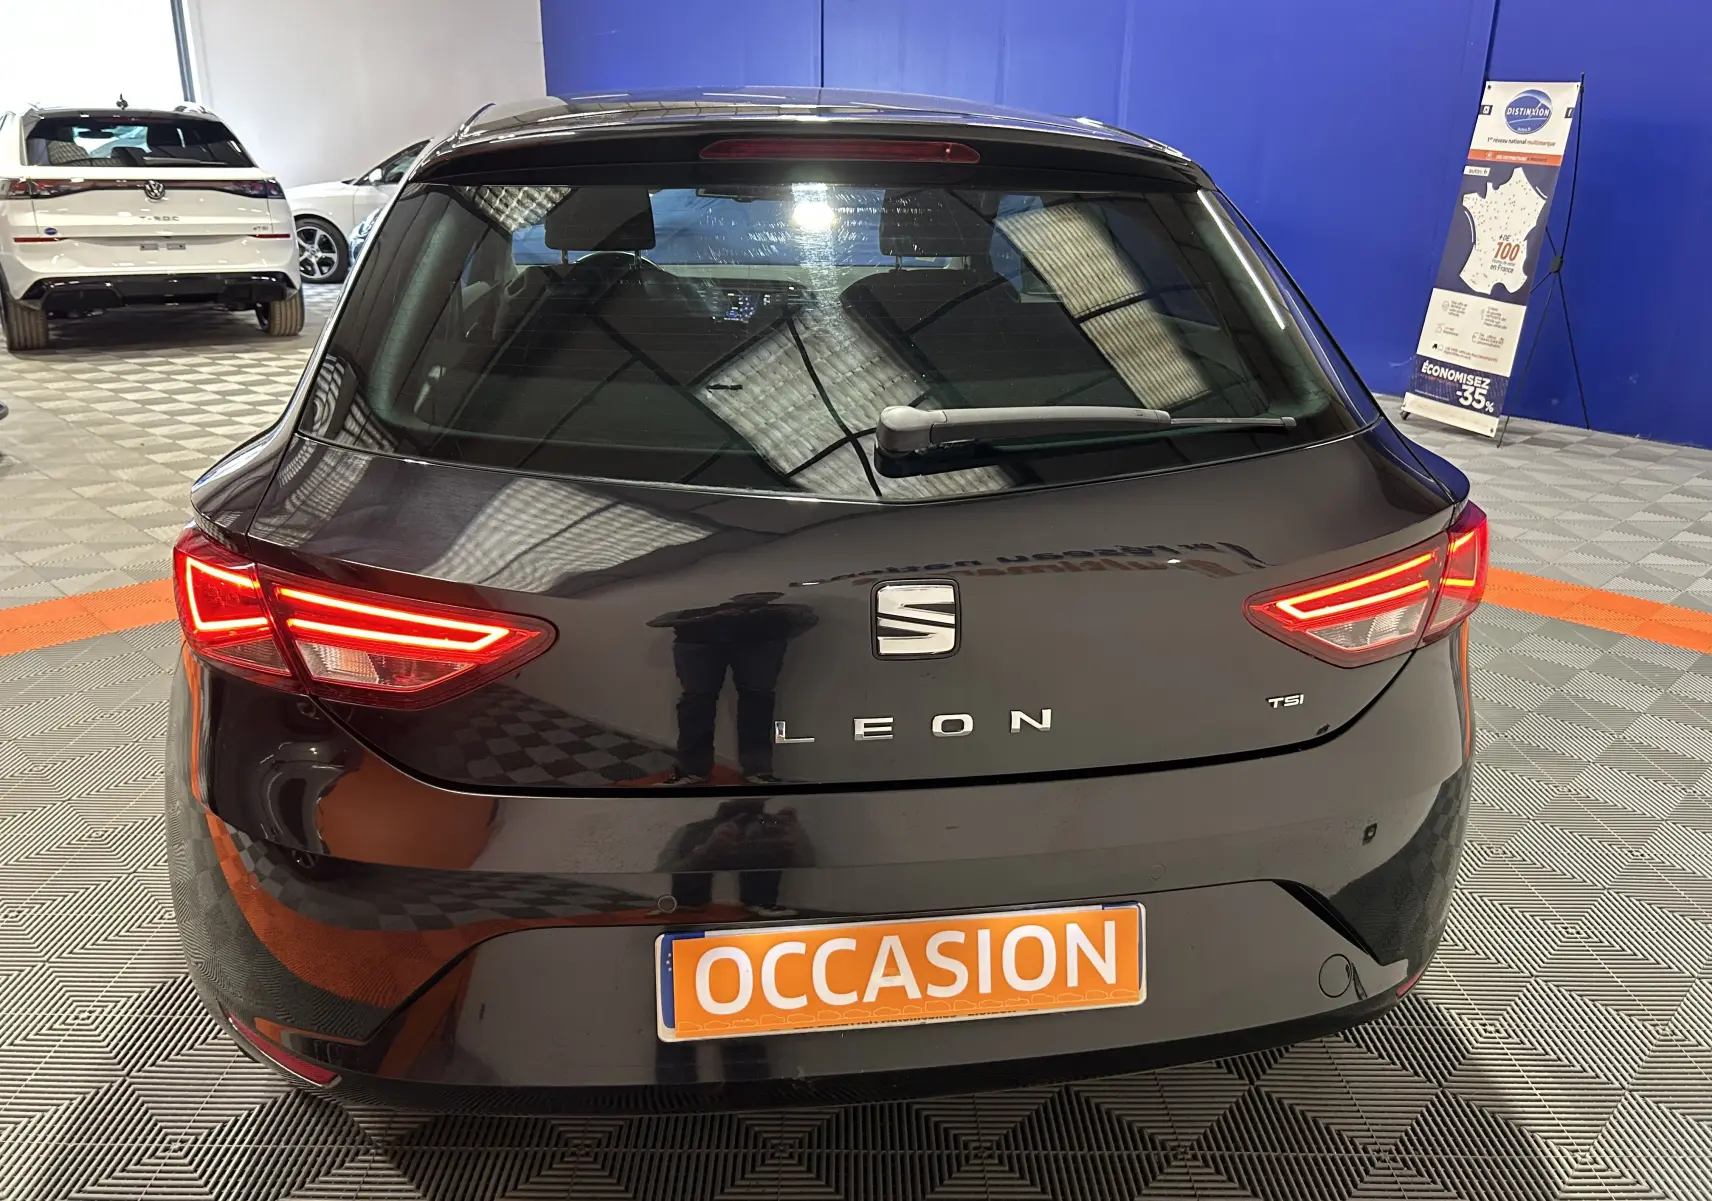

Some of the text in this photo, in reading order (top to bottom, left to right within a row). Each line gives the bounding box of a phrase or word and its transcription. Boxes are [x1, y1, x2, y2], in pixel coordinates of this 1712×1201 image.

[1507, 107, 1550, 117] DISTINXION
[1494, 242, 1521, 261] 100
[1497, 264, 1514, 274] France
[1421, 360, 1491, 389] ÉCONOMISEZ
[1267, 693, 1305, 709] TSI
[775, 708, 1053, 744] LEON
[694, 919, 1117, 1017] OCCASION
